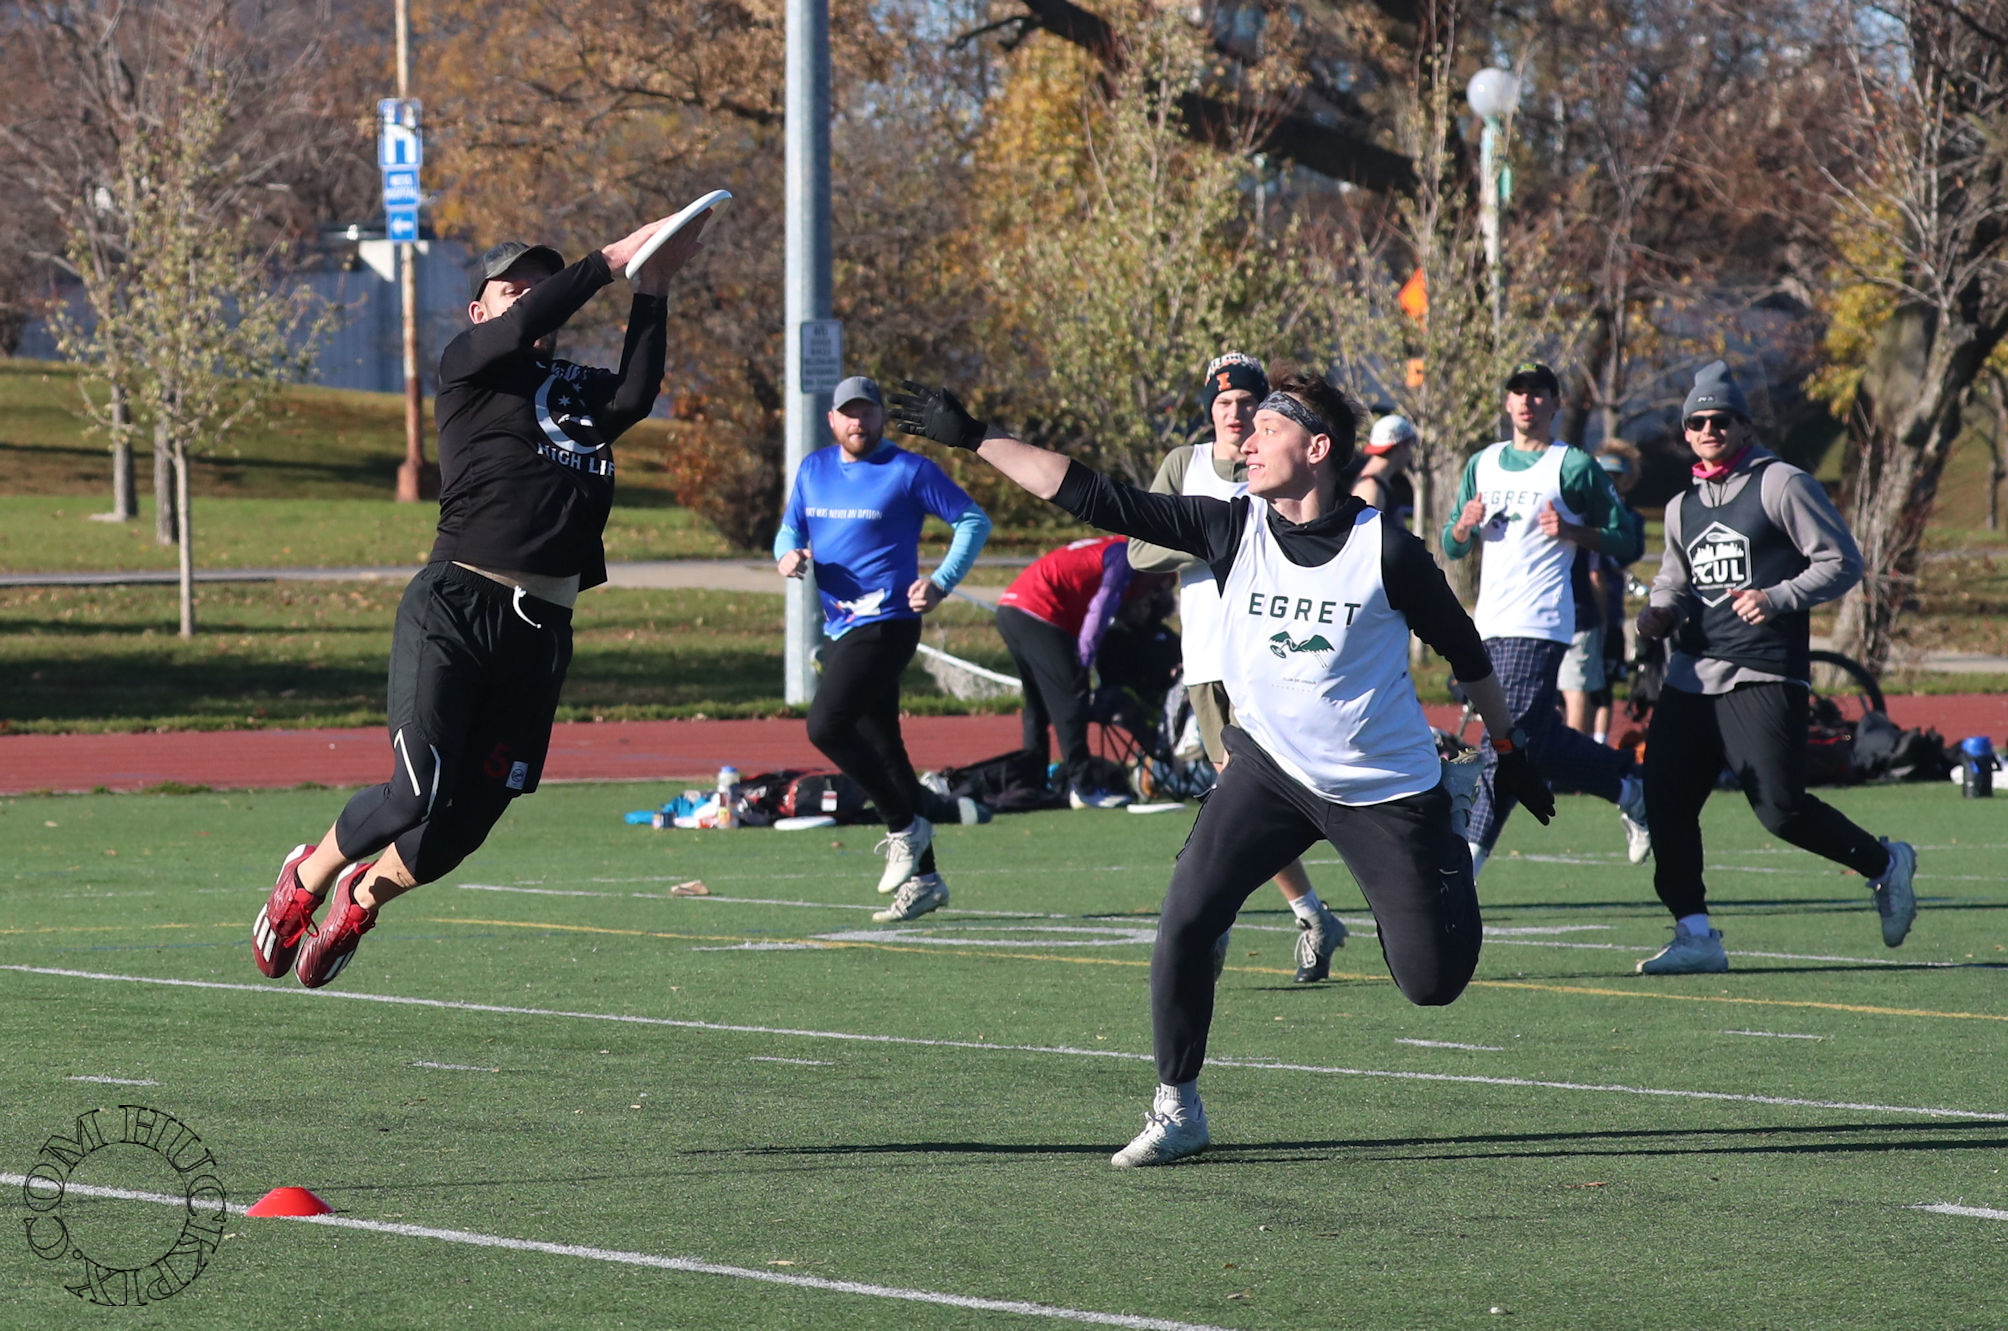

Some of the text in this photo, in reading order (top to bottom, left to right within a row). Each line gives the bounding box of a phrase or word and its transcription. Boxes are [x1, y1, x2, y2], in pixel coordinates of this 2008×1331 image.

[537, 442, 581, 470] HIGH
[857, 509, 883, 520] OPTION
[1248, 592, 1362, 626] EGRET
